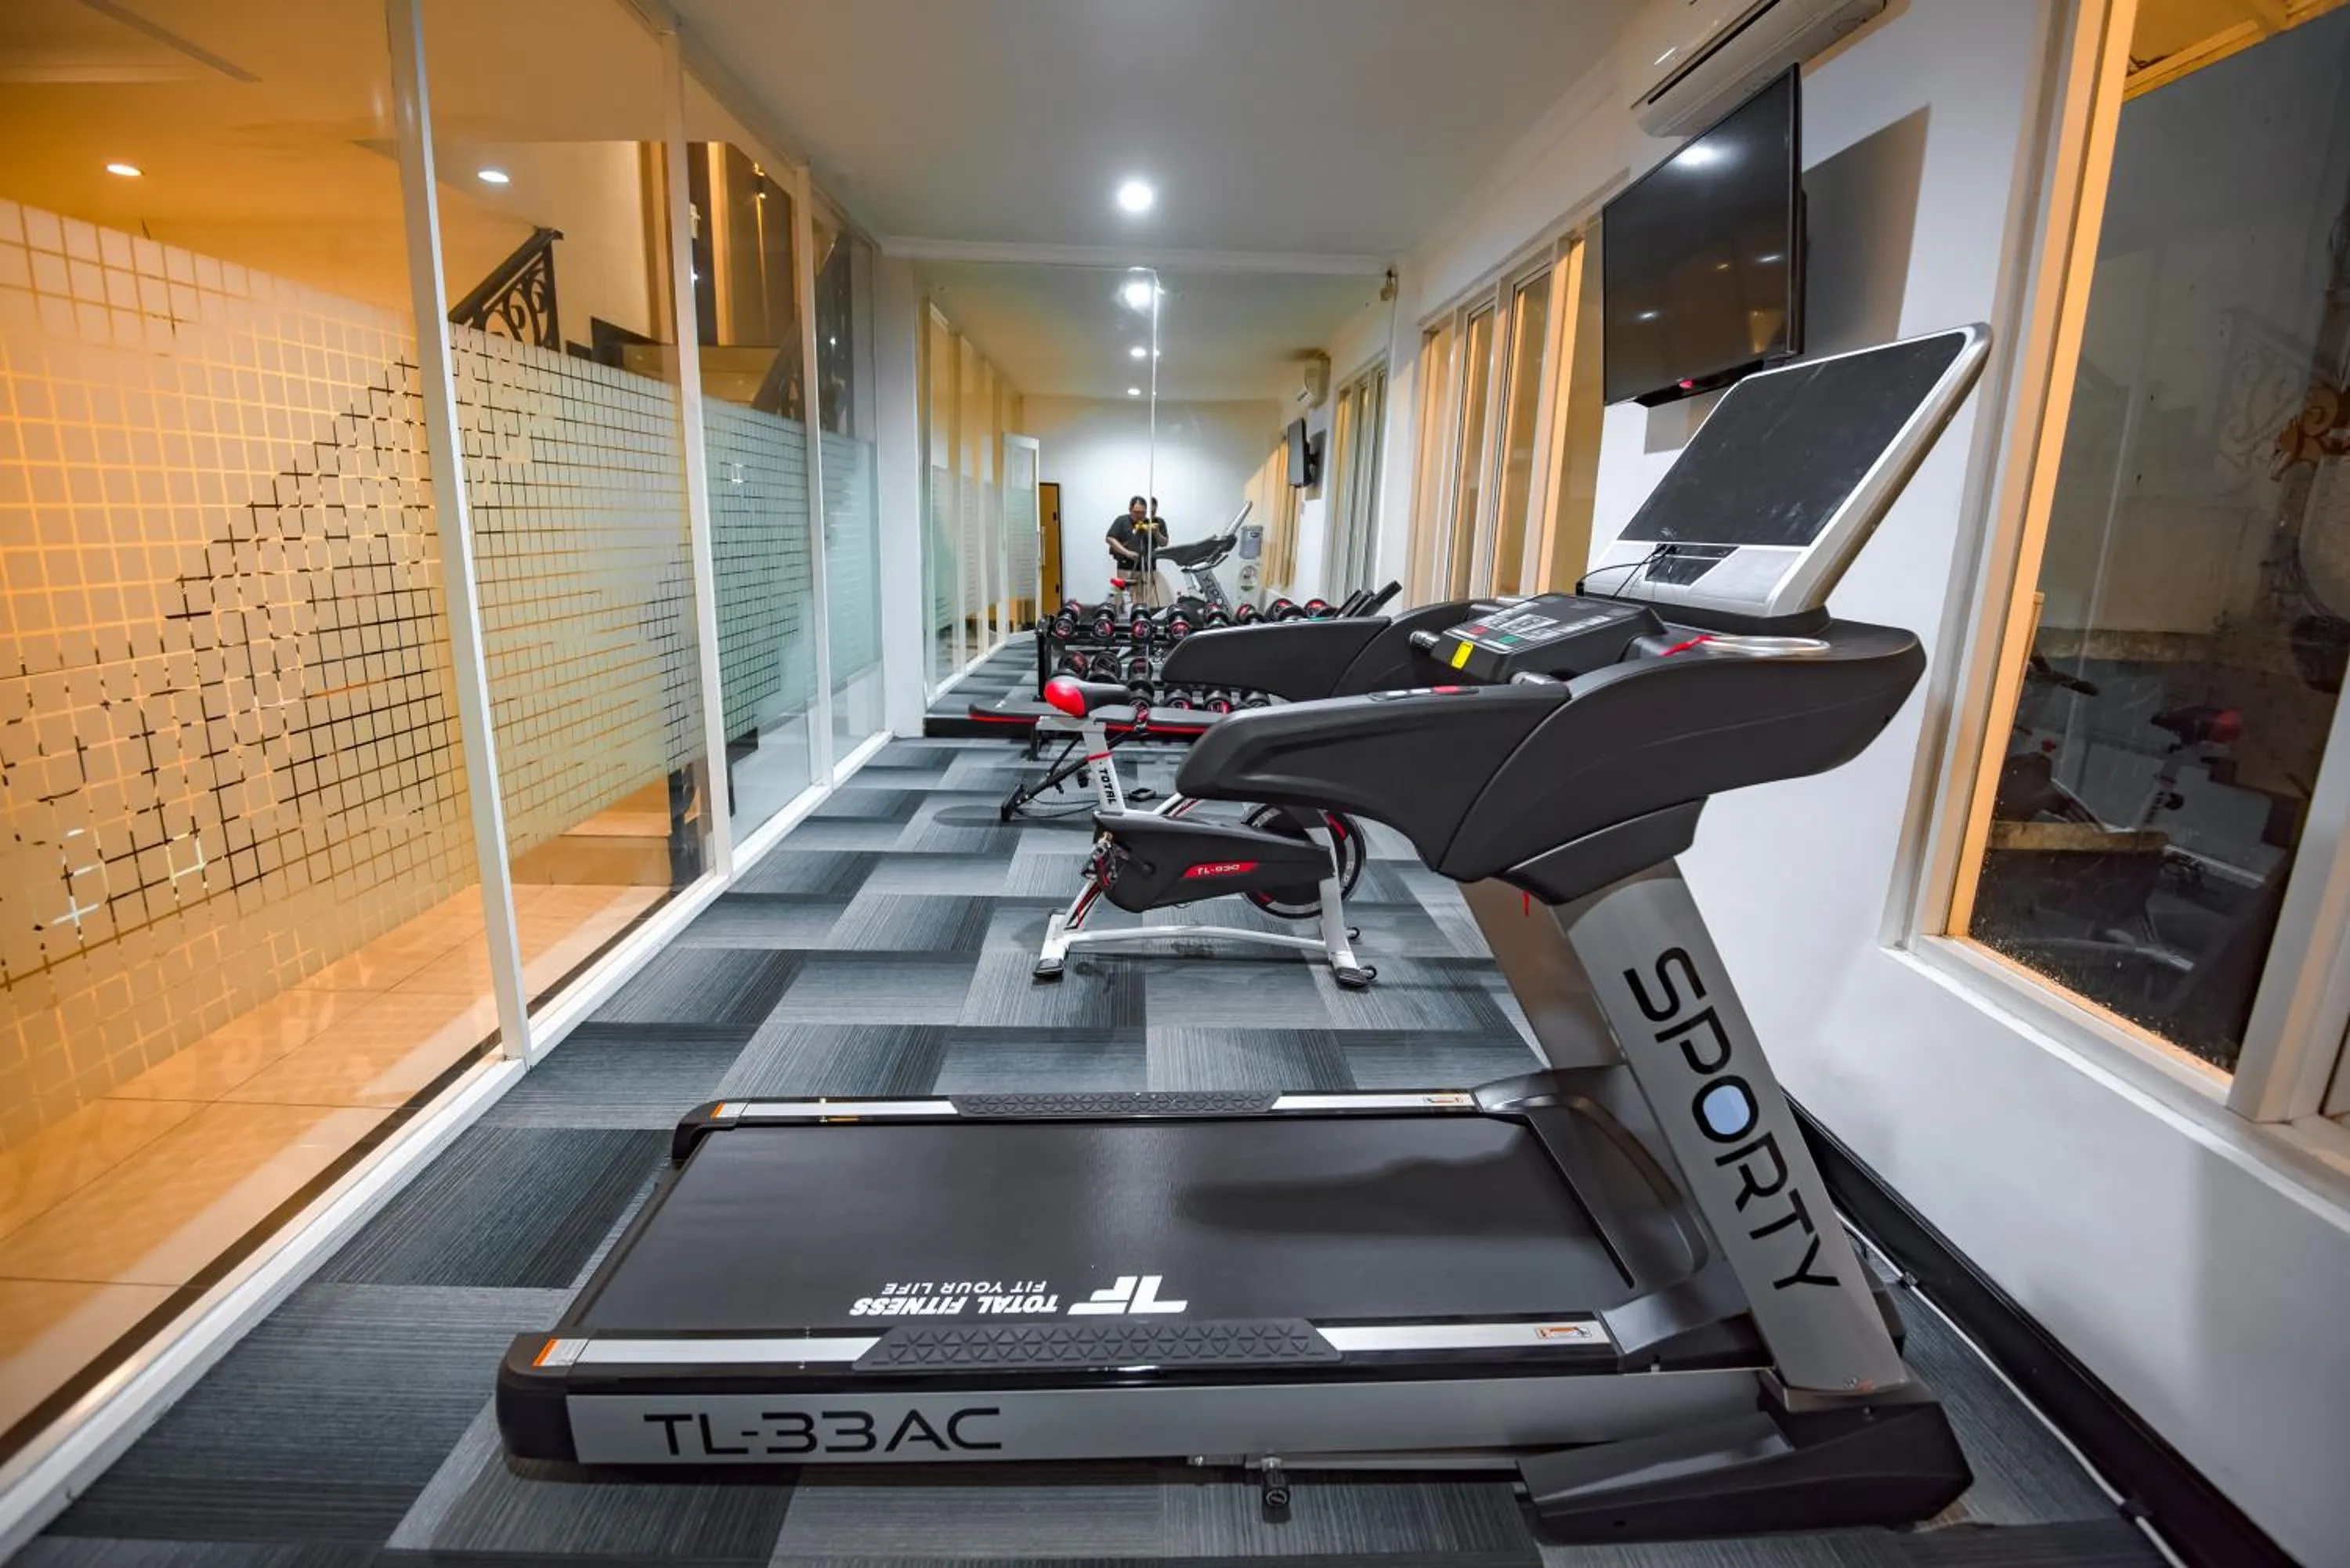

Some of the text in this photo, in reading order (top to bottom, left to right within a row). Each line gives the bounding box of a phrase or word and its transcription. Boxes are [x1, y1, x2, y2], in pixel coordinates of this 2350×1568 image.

[1098, 768, 1117, 805] TOTAL
[1622, 947, 1841, 1291] SPORTY
[848, 1294, 1059, 1317] TOTAL FITNESS
[881, 1281, 1047, 1295] FIT YOUR LIFE
[642, 1407, 1003, 1457] TL-33AC
